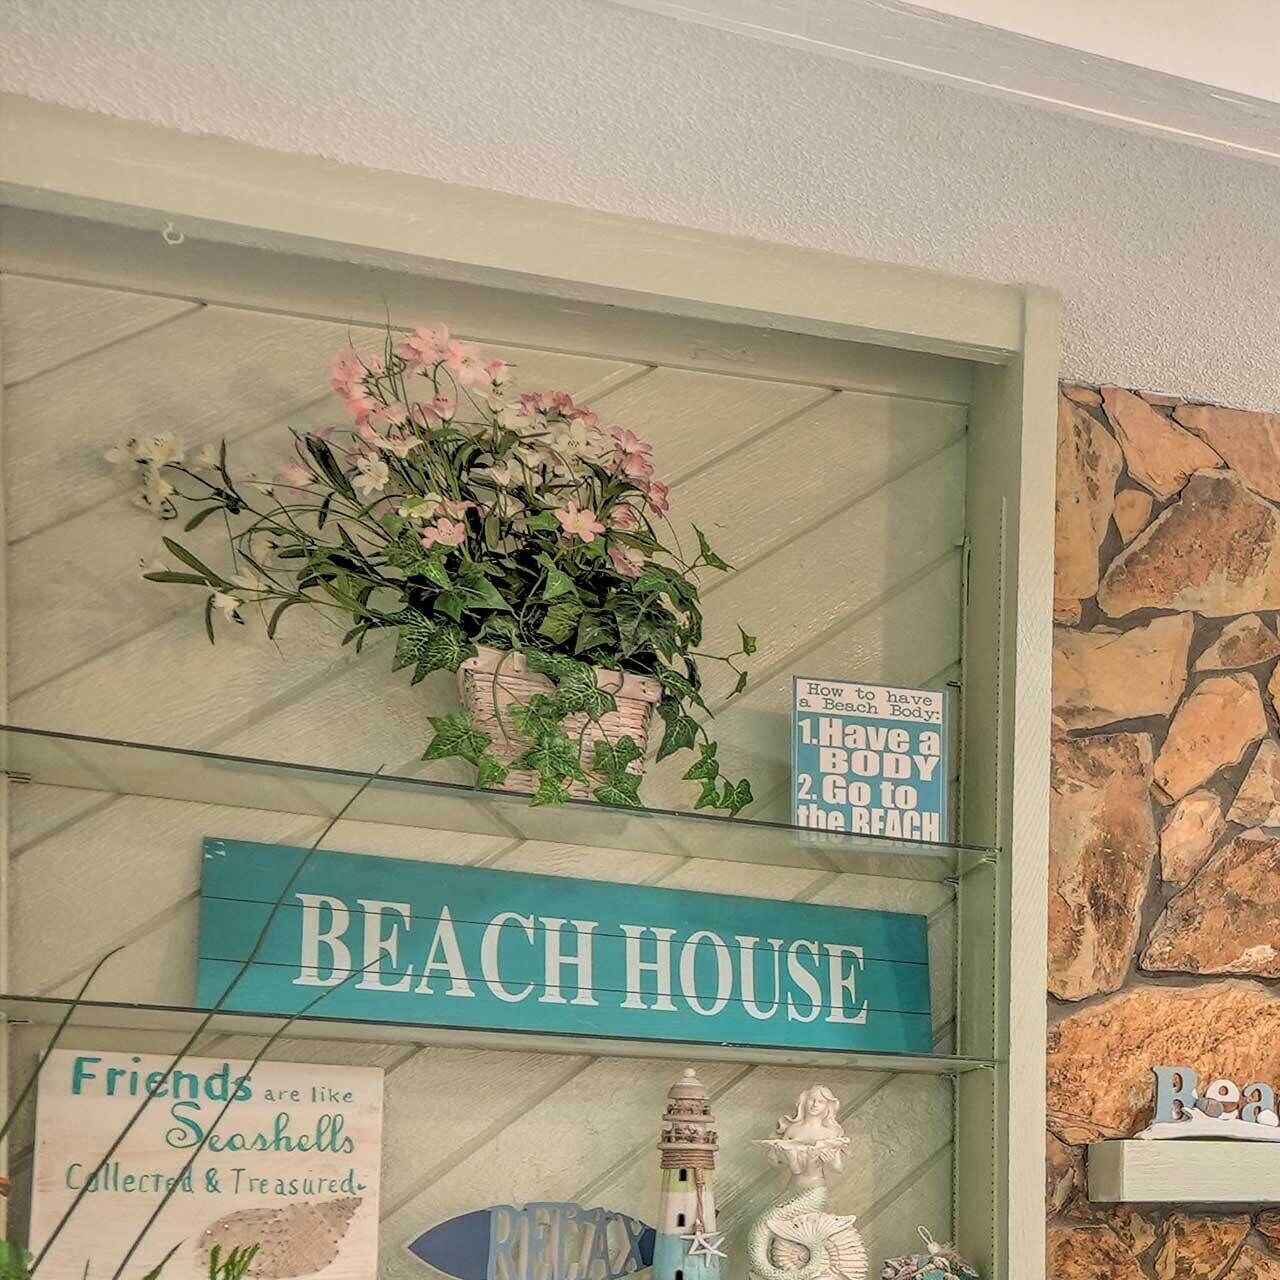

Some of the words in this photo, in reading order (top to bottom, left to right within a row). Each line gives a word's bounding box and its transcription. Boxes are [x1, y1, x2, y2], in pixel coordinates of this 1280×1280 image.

[799, 698, 811, 709] a
[822, 698, 878, 715] Beach
[889, 704, 941, 722] Body:
[807, 682, 843, 698] How
[855, 687, 875, 700] to
[887, 691, 933, 707] have
[918, 731, 941, 757] a
[819, 747, 941, 782] BODY
[822, 775, 872, 807] Go
[879, 779, 918, 810] to
[797, 803, 846, 832] the
[291, 891, 600, 1007] BEACH
[618, 924, 869, 1026] HOUSE
[70, 1055, 253, 1103] Friends
[264, 1087, 301, 1102] are
[311, 1086, 354, 1104] like
[165, 1100, 355, 1155] Seashells
[65, 1162, 194, 1194] Collected
[205, 1167, 222, 1194] &
